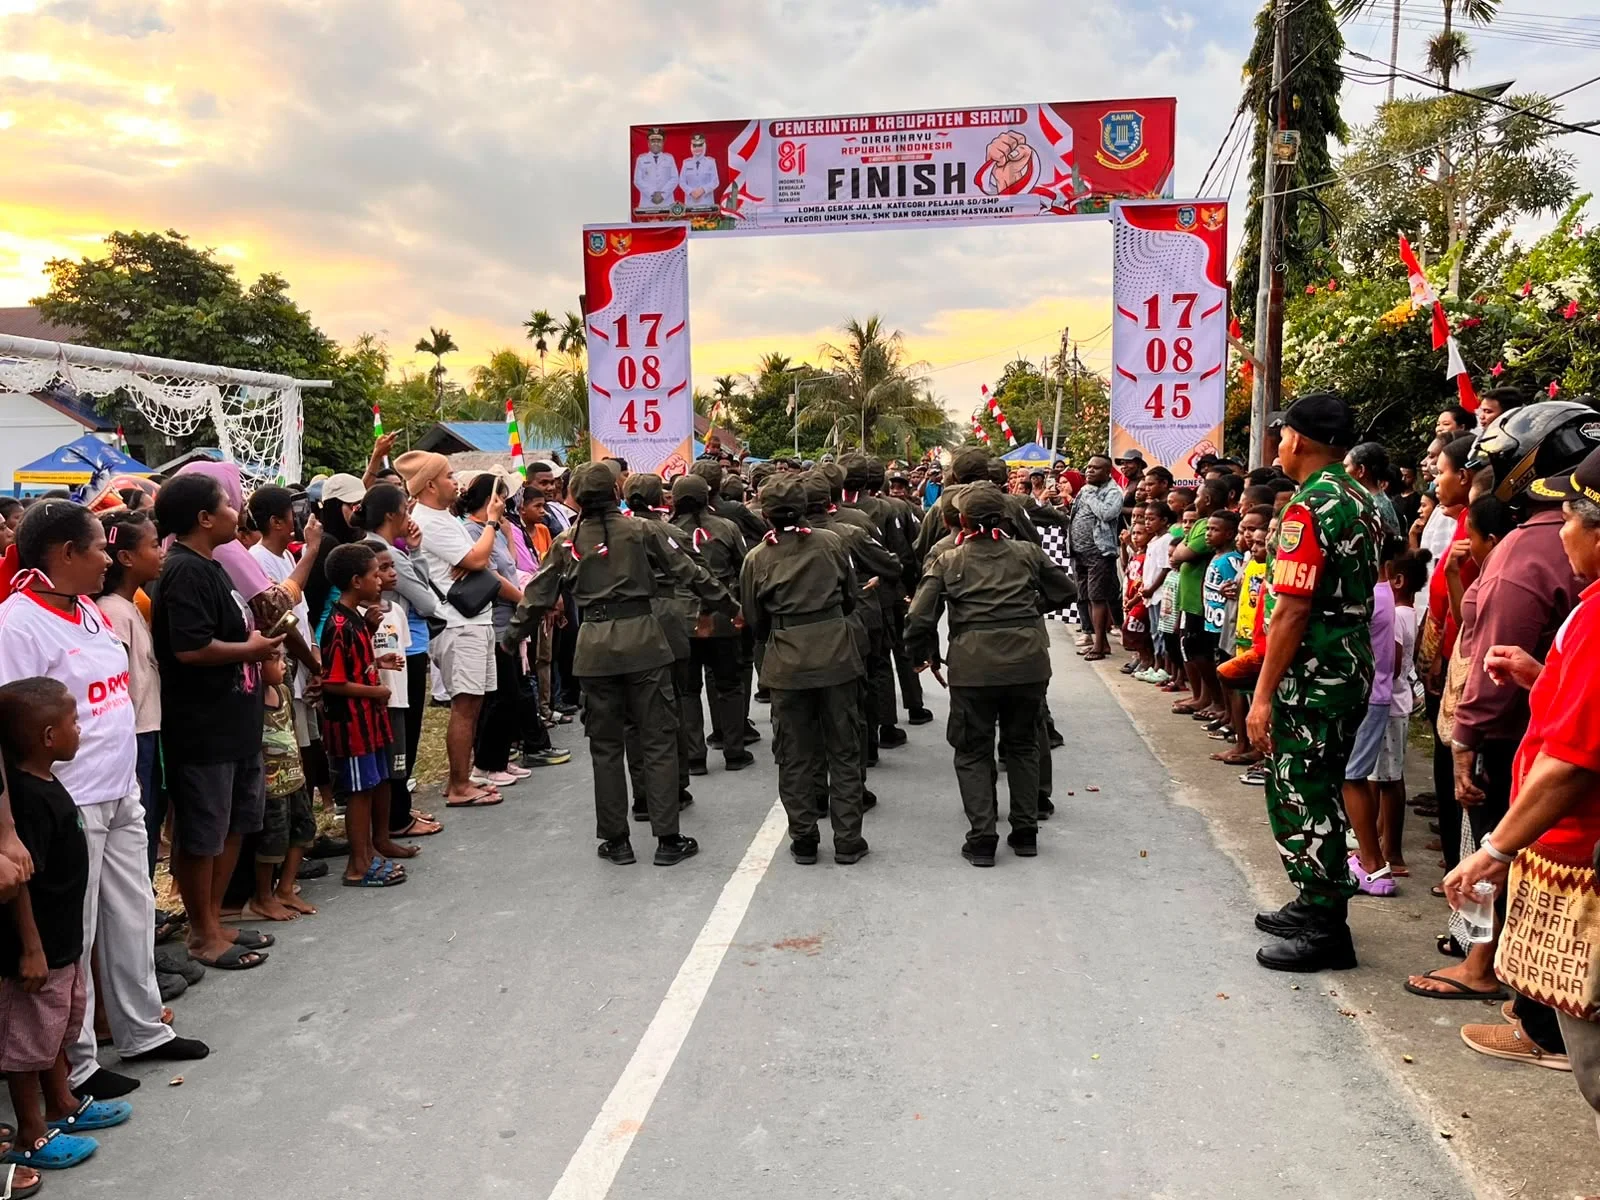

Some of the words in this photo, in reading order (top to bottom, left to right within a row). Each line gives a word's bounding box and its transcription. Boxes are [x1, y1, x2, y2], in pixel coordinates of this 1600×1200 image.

[775, 118, 869, 136] PEMERINTAH
[876, 112, 963, 131] KABUPATEN
[970, 109, 1021, 124] SARMI
[861, 132, 932, 144] DIRGAHAYU
[778, 140, 807, 176] 81
[841, 143, 892, 155] REPUBLIK
[895, 141, 953, 152] INDONESIA
[827, 162, 966, 201] FINISH
[784, 215, 822, 224] KATEGORI
[824, 214, 849, 222] UMUM
[872, 212, 891, 220] SMK
[892, 210, 909, 219] DAN
[911, 208, 959, 218] ORGANISASI
[961, 206, 1015, 216] MASYARAKAT
[798, 205, 826, 214] LOMBA
[827, 204, 855, 212] GERAK
[856, 203, 882, 211] JALAN
[887, 201, 926, 210] KATEGORI
[928, 199, 965, 208] PELAJAR
[967, 197, 999, 206] SD/SMP
[1143, 293, 1199, 330] 17
[612, 313, 664, 349] 17
[617, 355, 662, 390] 08
[1145, 336, 1193, 374] 08
[618, 398, 663, 435] 45
[1144, 382, 1192, 420] 45
[1510, 898, 1578, 937] ARMATI
[1506, 916, 1591, 959] RUMBUAI
